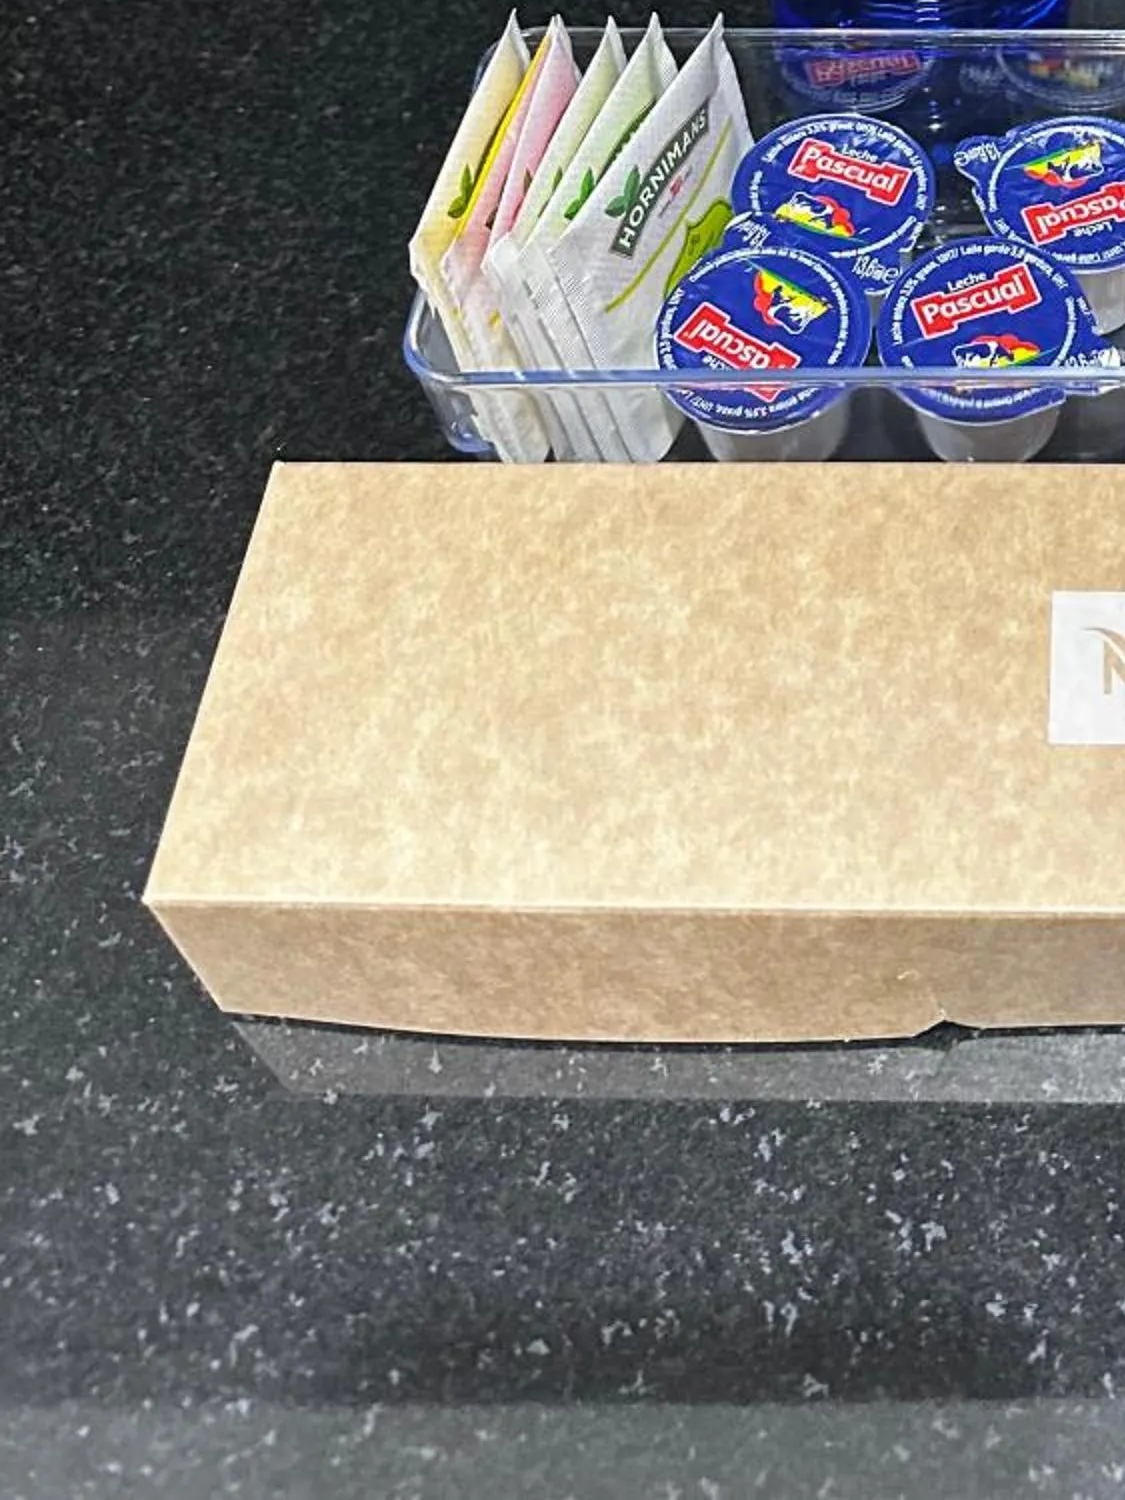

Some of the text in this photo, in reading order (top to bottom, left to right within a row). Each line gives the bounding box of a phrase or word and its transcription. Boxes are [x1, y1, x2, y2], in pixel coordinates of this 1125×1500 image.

[801, 147, 899, 193] Pascual
[841, 143, 879, 163] Leche
[618, 108, 707, 249] HORNIMANS
[1073, 221, 1113, 238] Leche
[921, 274, 1027, 325] Pascual
[947, 272, 988, 292] Leche
[686, 318, 786, 369] ascual
